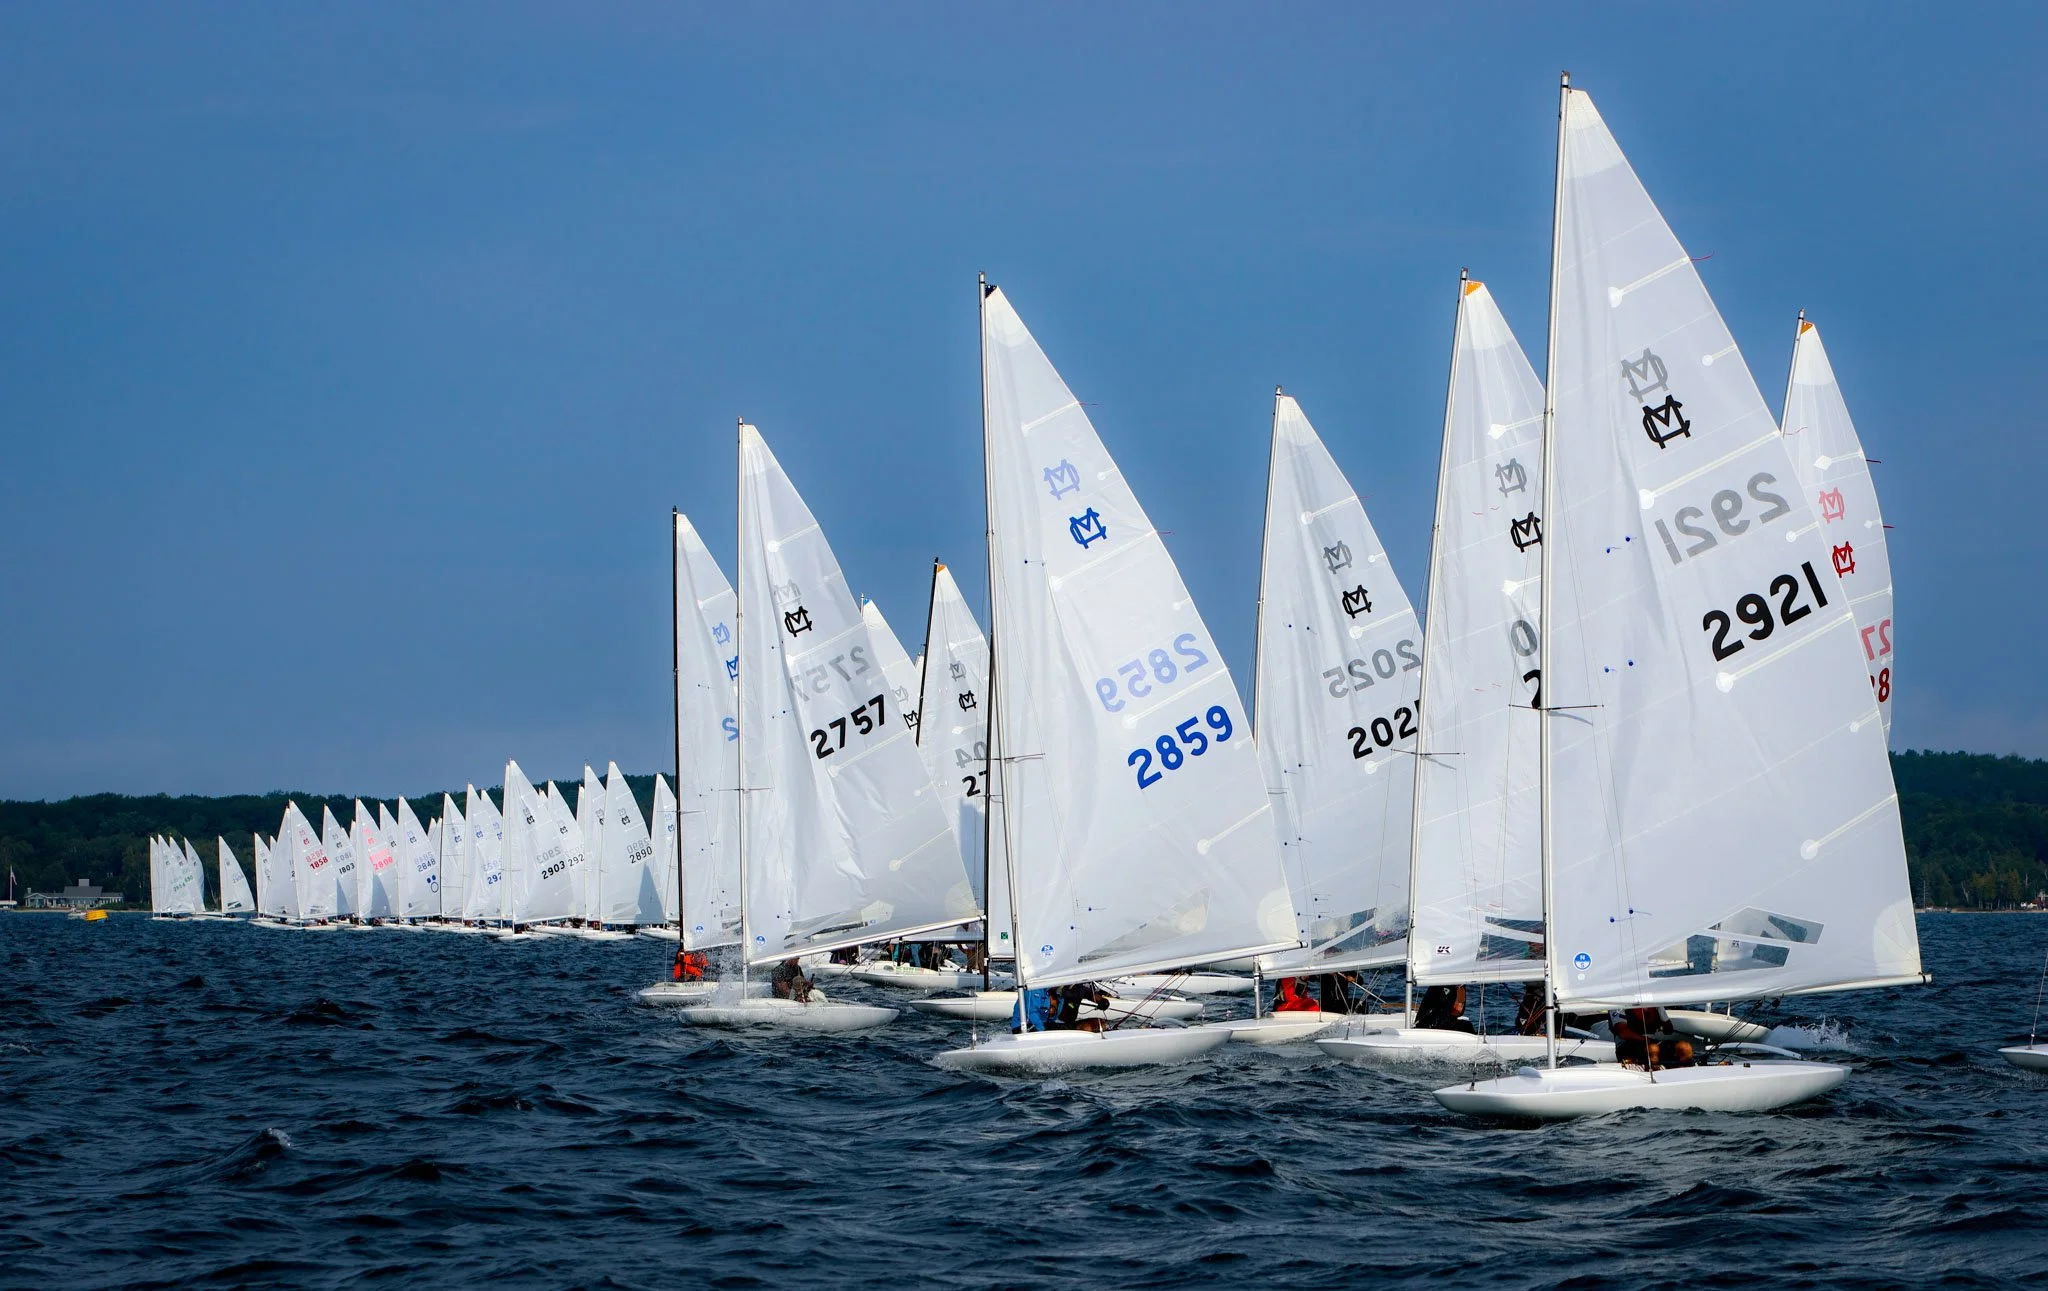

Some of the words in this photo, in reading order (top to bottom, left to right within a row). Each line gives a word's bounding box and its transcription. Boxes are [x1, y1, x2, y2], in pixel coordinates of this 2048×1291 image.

[1702, 561, 1829, 662] 2921
[810, 694, 887, 760] 2757
[1127, 705, 1234, 790] 2859
[309, 856, 329, 870] 1858
[373, 856, 393, 871] 2800
[629, 846, 653, 864] 2890
[339, 862, 355, 875] 1803
[416, 858, 436, 873] 2848
[541, 860, 566, 880] 2903
